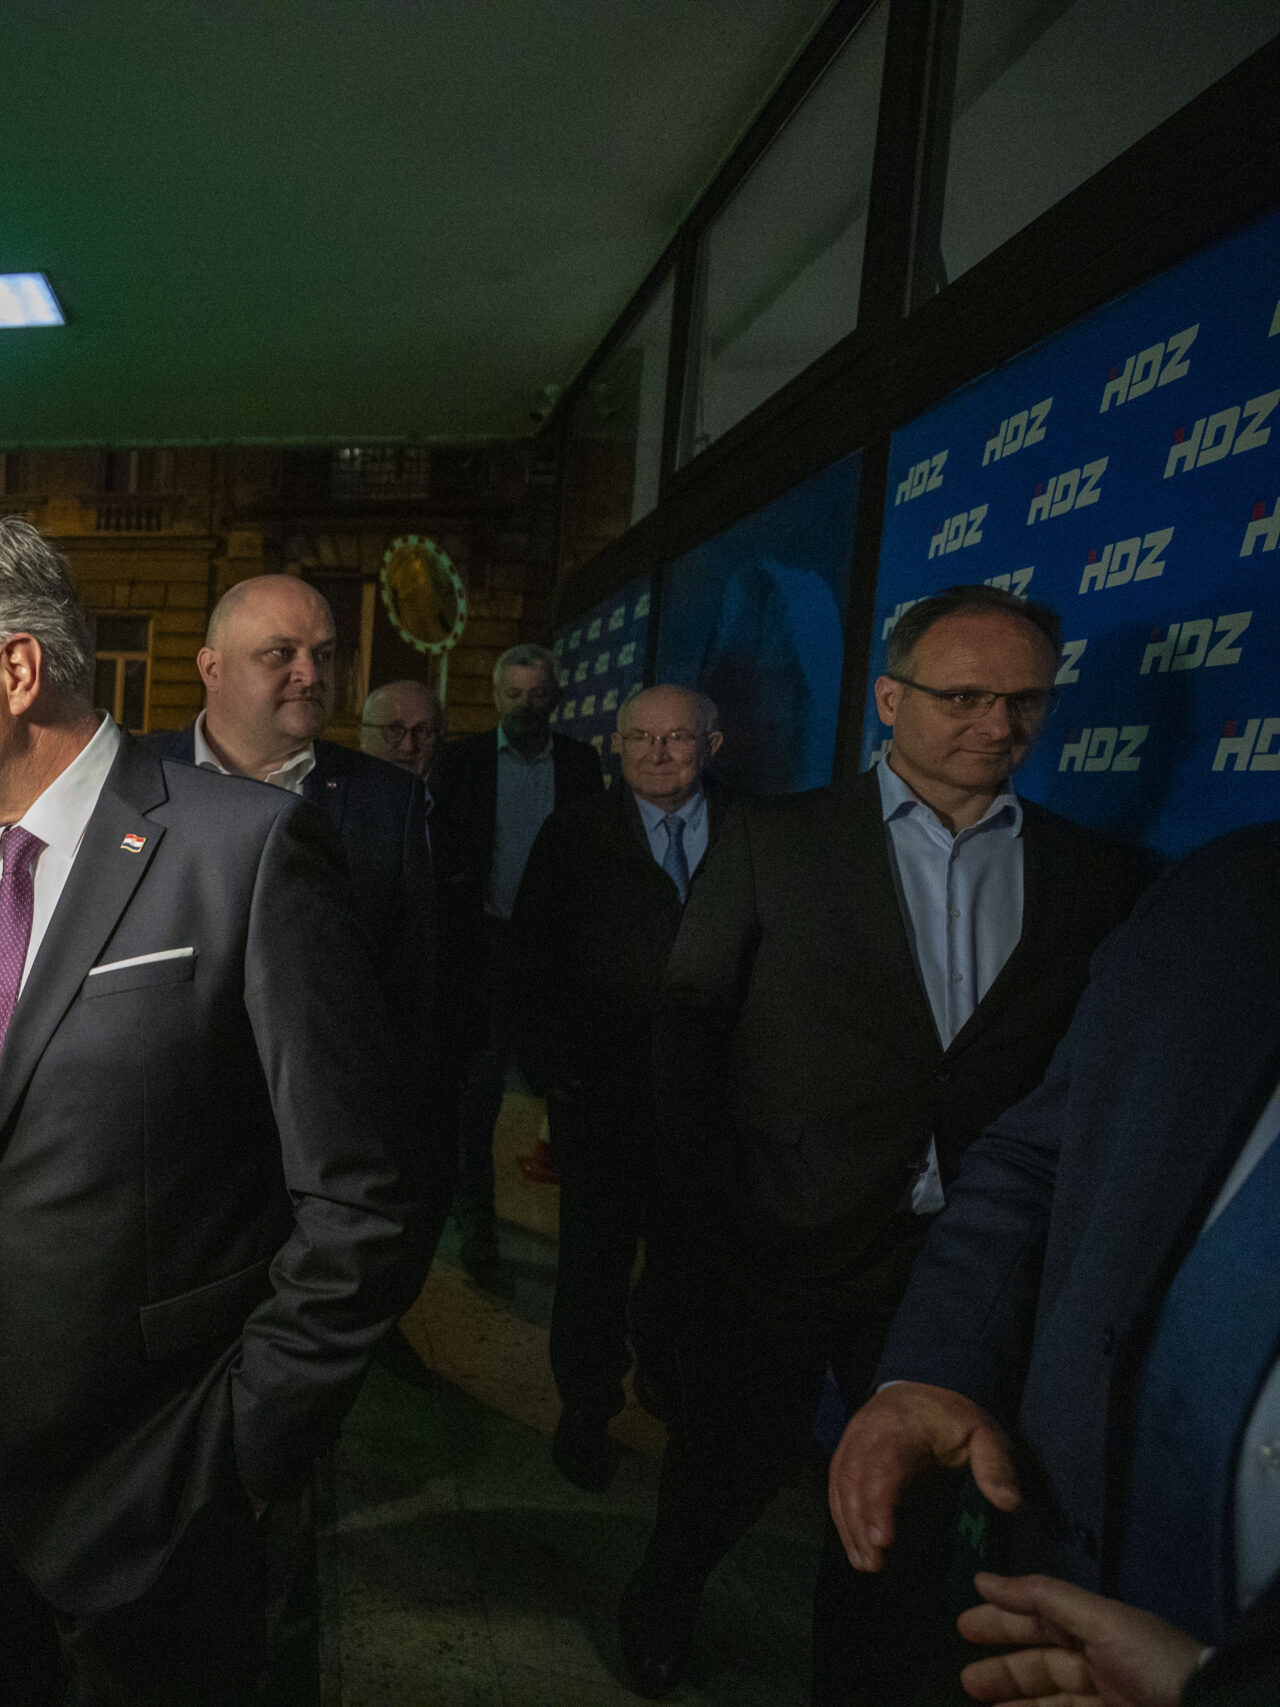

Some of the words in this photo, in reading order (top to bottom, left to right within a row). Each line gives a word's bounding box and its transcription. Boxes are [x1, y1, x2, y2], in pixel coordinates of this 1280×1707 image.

[1100, 323, 1200, 414] HDZ
[982, 397, 1054, 467] HDZ
[1163, 388, 1280, 479] HDZ
[895, 449, 949, 506] HDZ
[1026, 456, 1109, 526] HDZ
[928, 503, 989, 560] HDZ
[1078, 526, 1175, 595] HDZ
[1140, 611, 1254, 675] HDZ
[1058, 724, 1151, 772] HDZ
